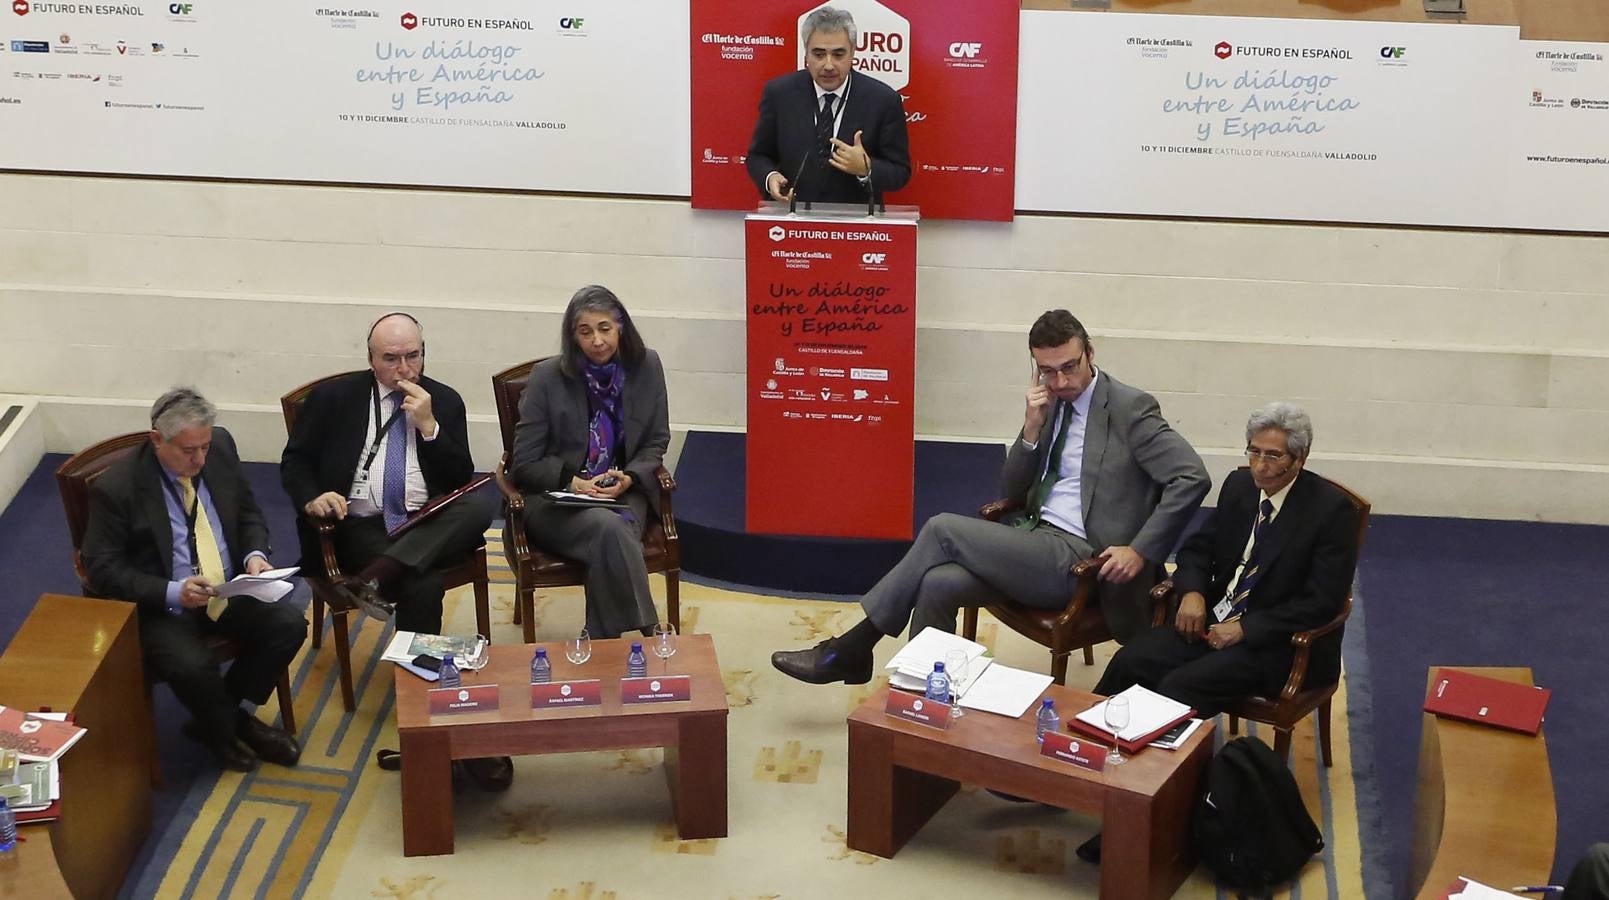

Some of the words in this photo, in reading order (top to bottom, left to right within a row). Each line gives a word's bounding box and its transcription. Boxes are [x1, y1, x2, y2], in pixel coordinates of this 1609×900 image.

[34, 4, 76, 14] FUTURO
[79, 5, 94, 14] EN
[96, 3, 144, 16] ESPAÑOL
[170, 4, 192, 14] CAF
[422, 18, 465, 28] FUTURO
[468, 19, 482, 28] EN
[485, 17, 534, 31] ESPAÑOL
[560, 18, 584, 29] CAF
[702, 34, 712, 43] El
[713, 34, 734, 44] Norte
[735, 36, 743, 44] de
[744, 35, 774, 45] Castilla
[856, 32, 902, 53] URO
[376, 41, 416, 60] Un
[422, 39, 522, 64] diálogo
[950, 42, 982, 58] CAF
[1236, 46, 1281, 57] FUTURO
[1284, 48, 1299, 58] EN
[1302, 46, 1352, 60] ESPAÑOL
[1380, 46, 1406, 58] CAF
[1570, 52, 1595, 60] Castilla
[852, 54, 902, 72] PAÑOL
[356, 65, 424, 84] entre
[431, 62, 545, 83] América
[1185, 70, 1227, 91] Un
[1233, 69, 1338, 94] diálogo
[391, 92, 405, 110] y
[417, 85, 514, 110] España
[1163, 94, 1234, 114] entre
[1240, 92, 1360, 113] América
[365, 115, 408, 124] DICIEMBRE
[410, 117, 445, 125] CASTILLO
[516, 121, 566, 130] VALLADOLID
[1197, 123, 1212, 141] y
[1224, 116, 1325, 141] España
[1168, 146, 1213, 155] DICIEMBRE
[1214, 148, 1251, 156] CASTILLO
[1324, 152, 1377, 160] VALLADOLID
[788, 230, 828, 239] FUTURO
[831, 231, 844, 240] EN
[847, 230, 892, 242] ESPAÑOL
[862, 253, 886, 264] CAF
[769, 283, 804, 298] Un
[808, 281, 889, 300] diálogo
[753, 301, 808, 315] entre
[815, 299, 909, 315] América
[781, 323, 792, 336] y
[802, 317, 883, 336] España
